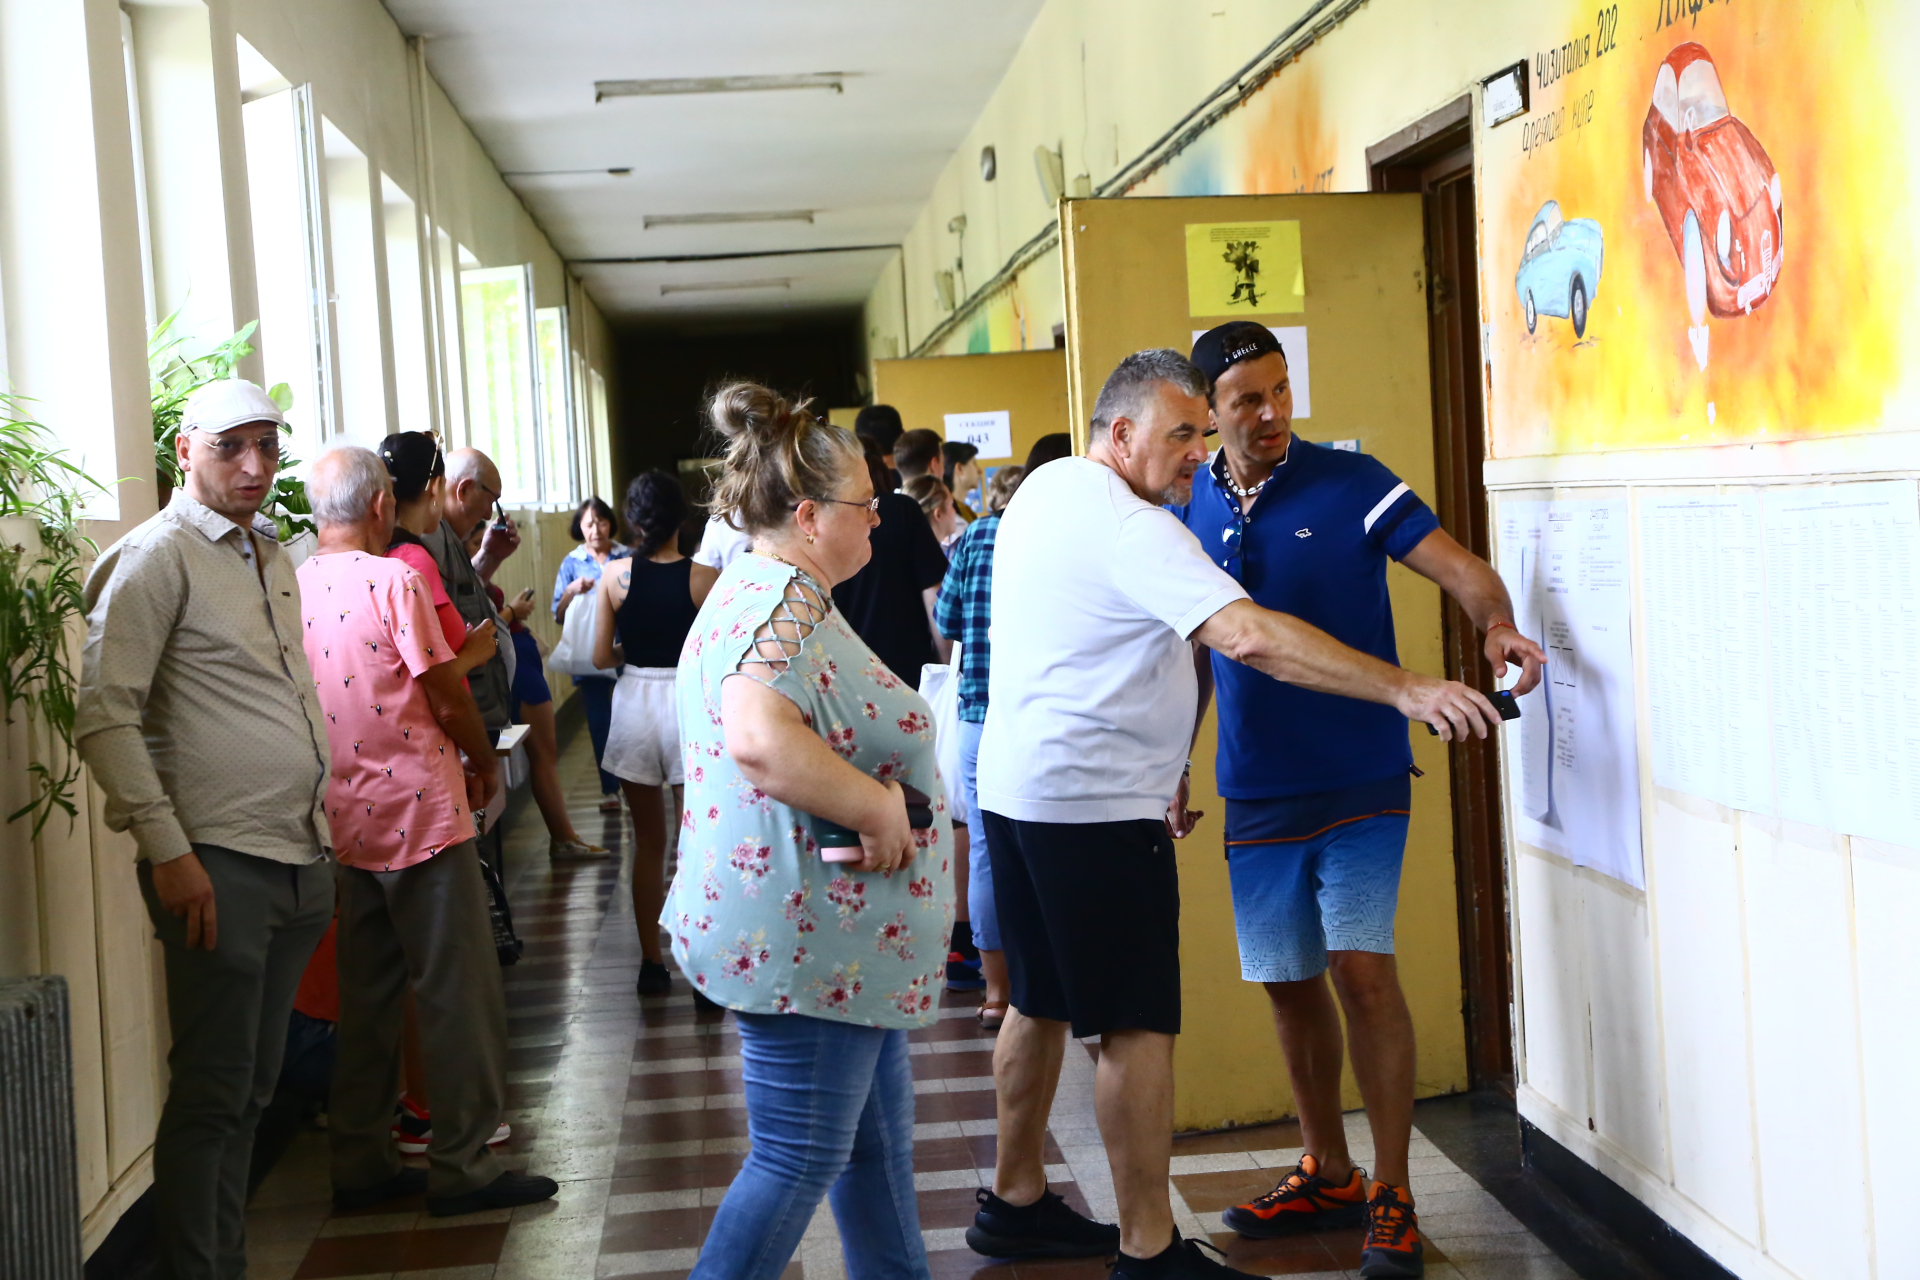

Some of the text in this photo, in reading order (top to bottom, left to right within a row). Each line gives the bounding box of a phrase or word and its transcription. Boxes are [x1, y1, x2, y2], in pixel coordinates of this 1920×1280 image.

[1596, 3, 1618, 58] 202
[1232, 342, 1258, 360] GREECE
[967, 432, 990, 444] 043
